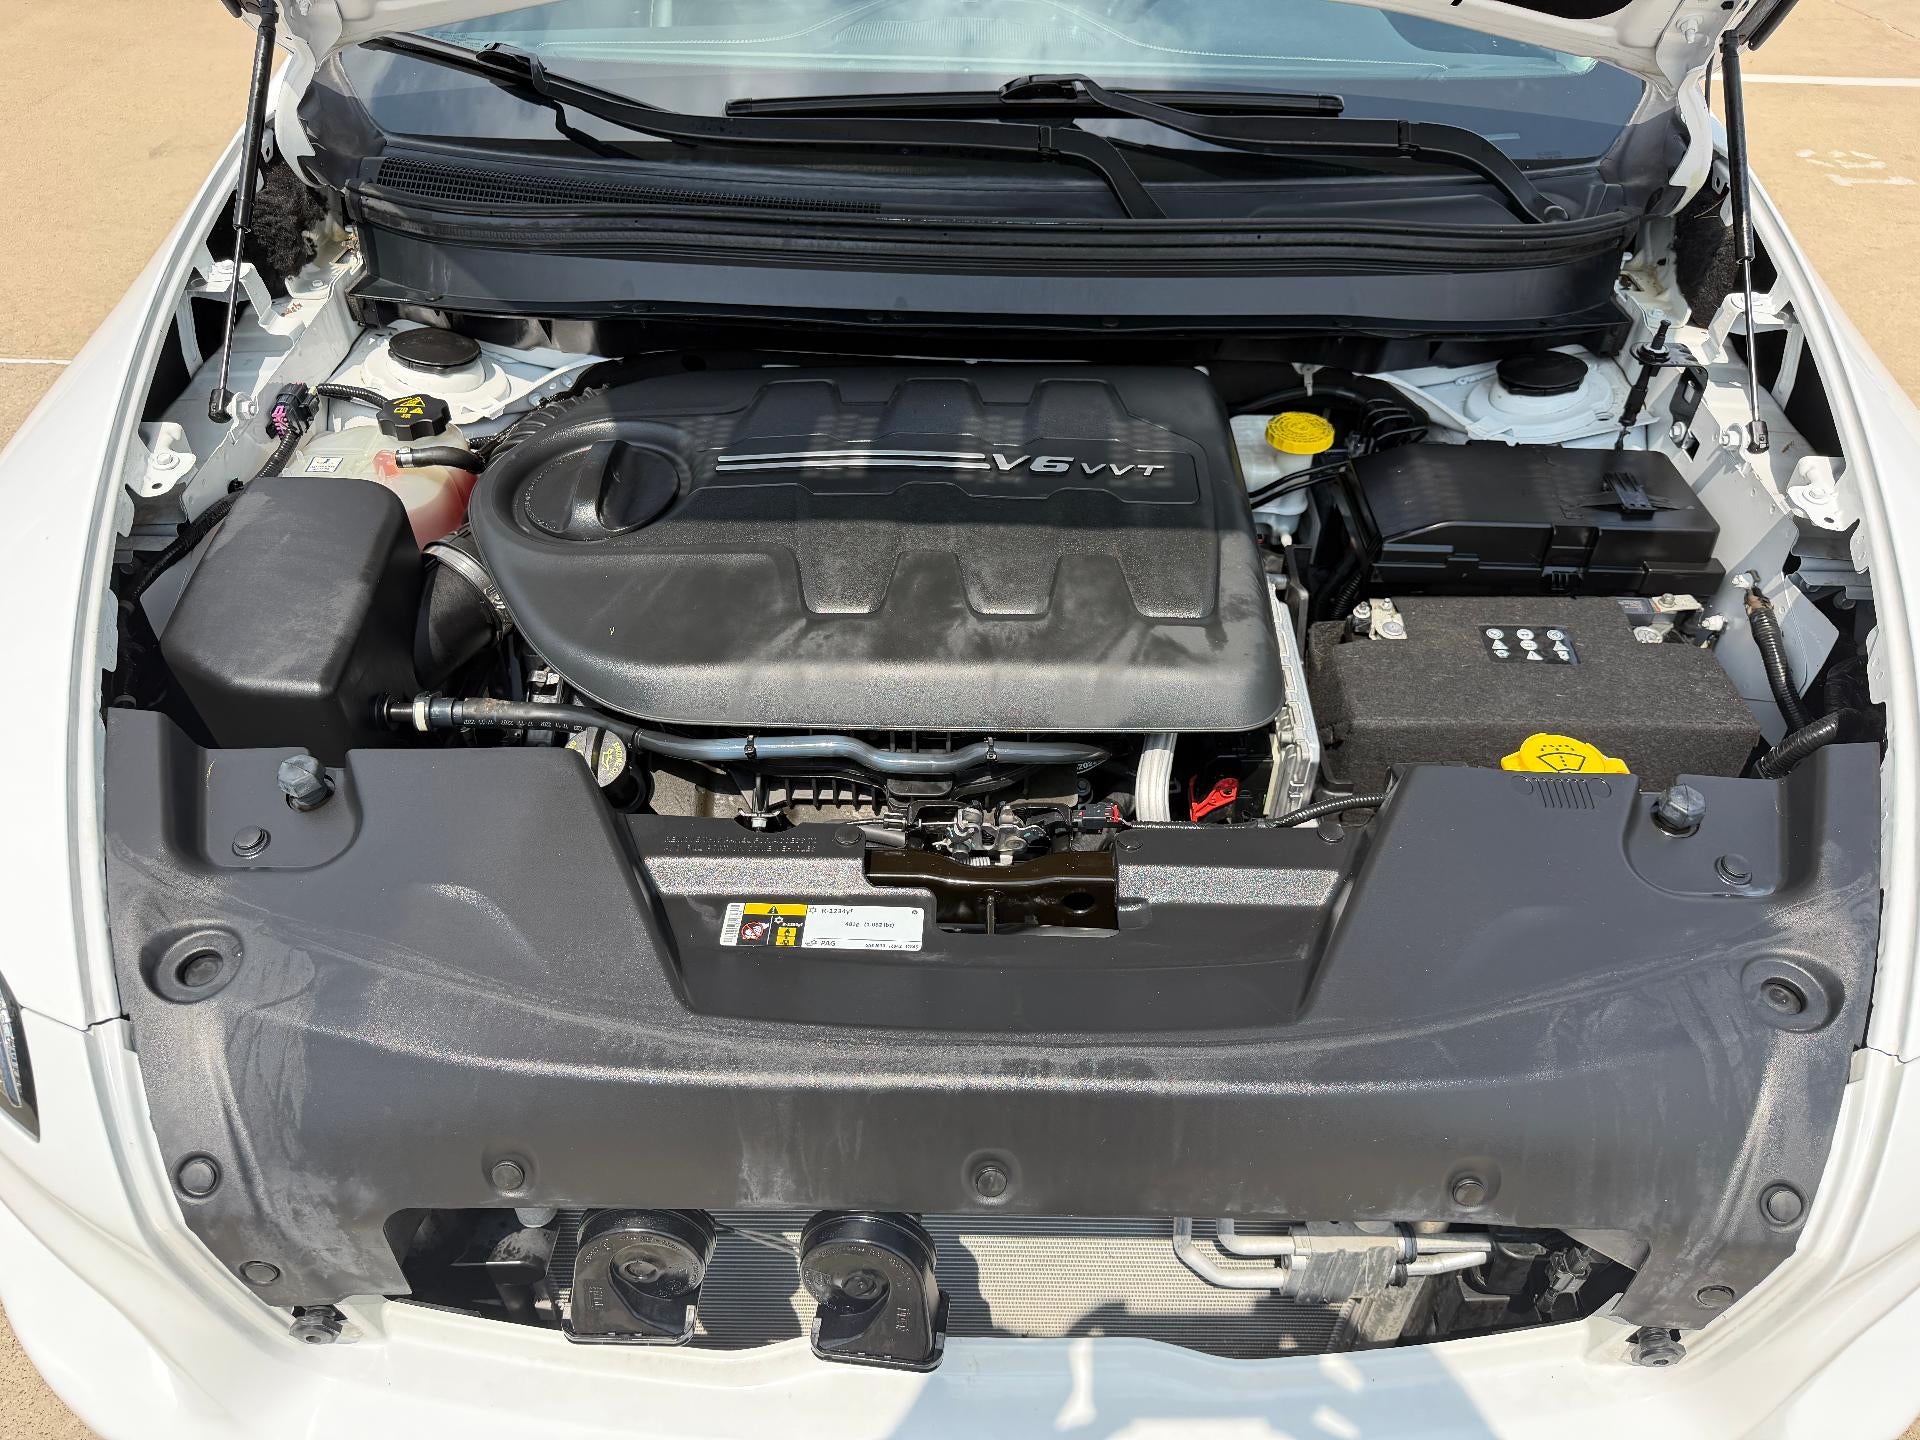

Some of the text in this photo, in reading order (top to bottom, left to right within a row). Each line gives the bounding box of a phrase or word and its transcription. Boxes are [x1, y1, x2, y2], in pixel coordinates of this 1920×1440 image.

[992, 453, 1165, 476] V6 VVT
[608, 741, 623, 779] ENGINE OIL
